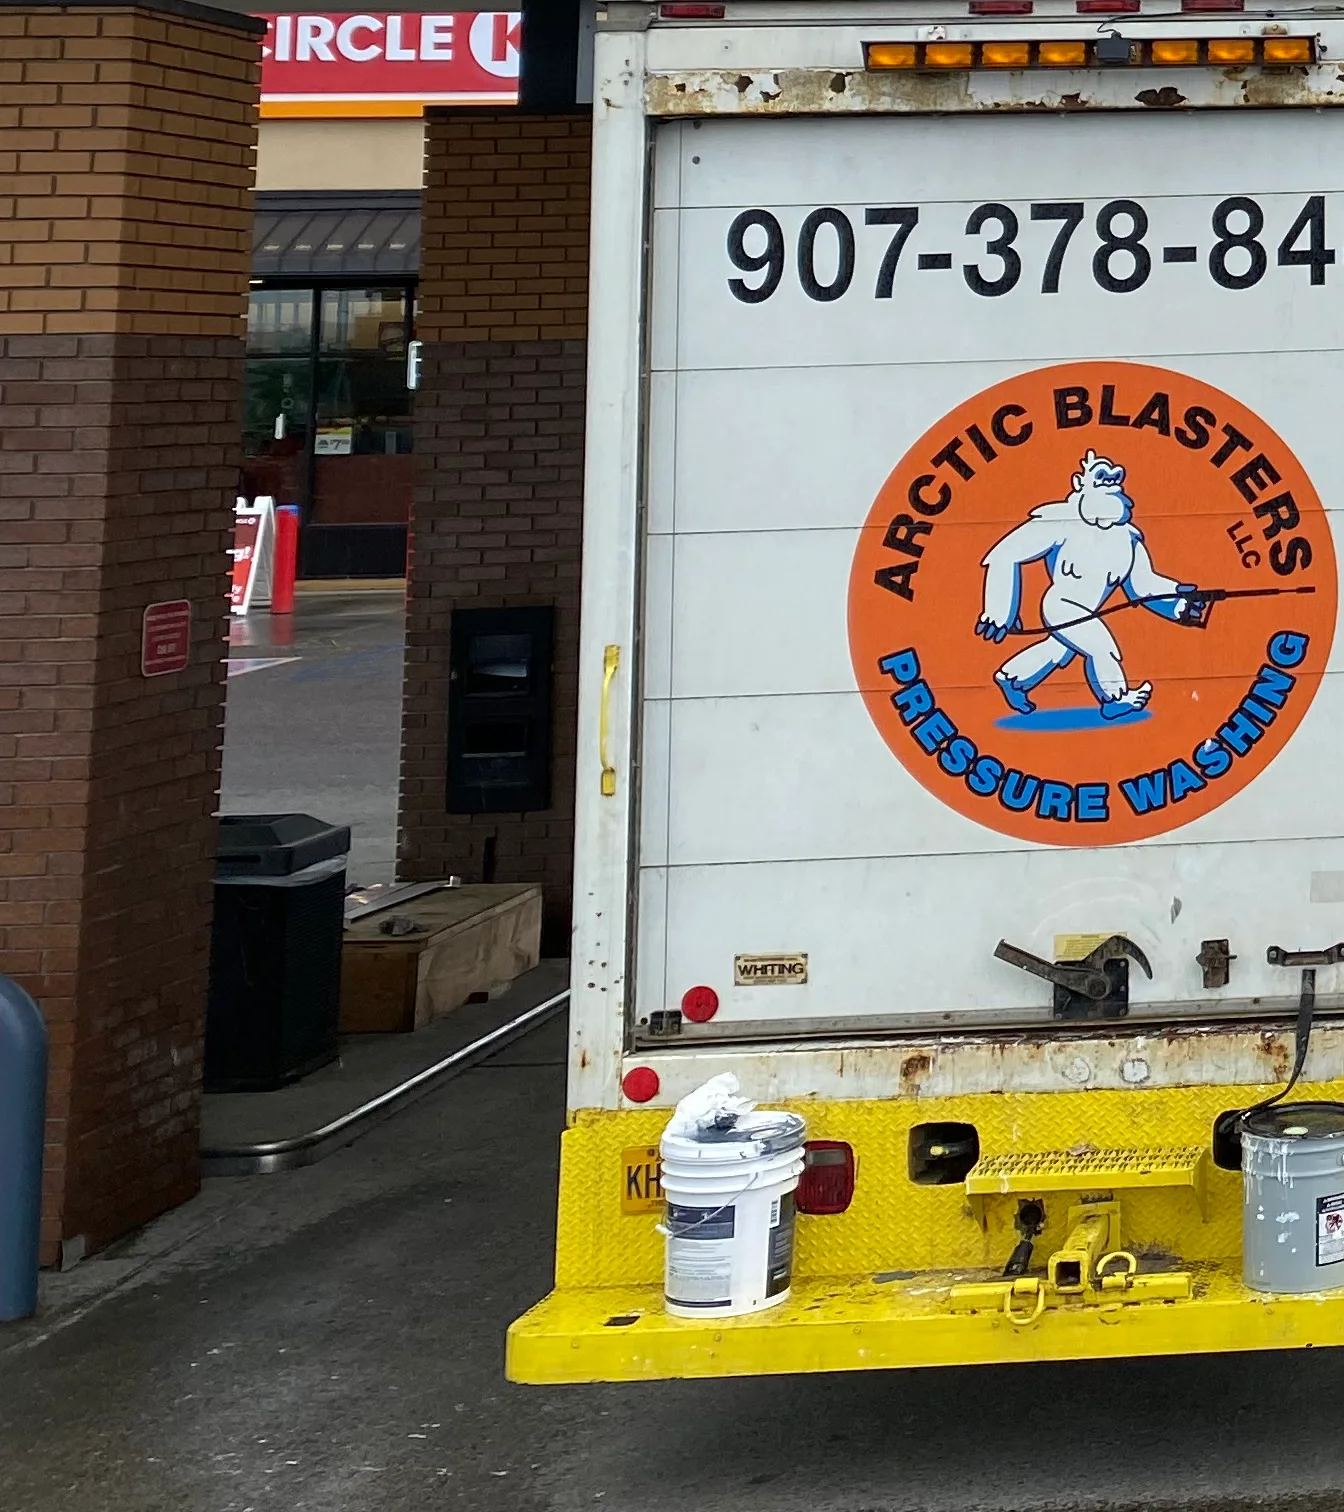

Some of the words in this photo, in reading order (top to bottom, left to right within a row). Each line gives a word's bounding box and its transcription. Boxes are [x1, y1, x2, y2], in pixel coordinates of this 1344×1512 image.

[262, 15, 454, 62] IRCLE
[874, 404, 1034, 602] ARCTIC
[1053, 385, 1313, 577] BLASTERS
[1226, 520, 1261, 570] LLC
[880, 646, 1109, 822] PRESSURE
[1119, 630, 1310, 814] WASHING
[737, 962, 805, 976] WHITING
[627, 1163, 661, 1201] KH
